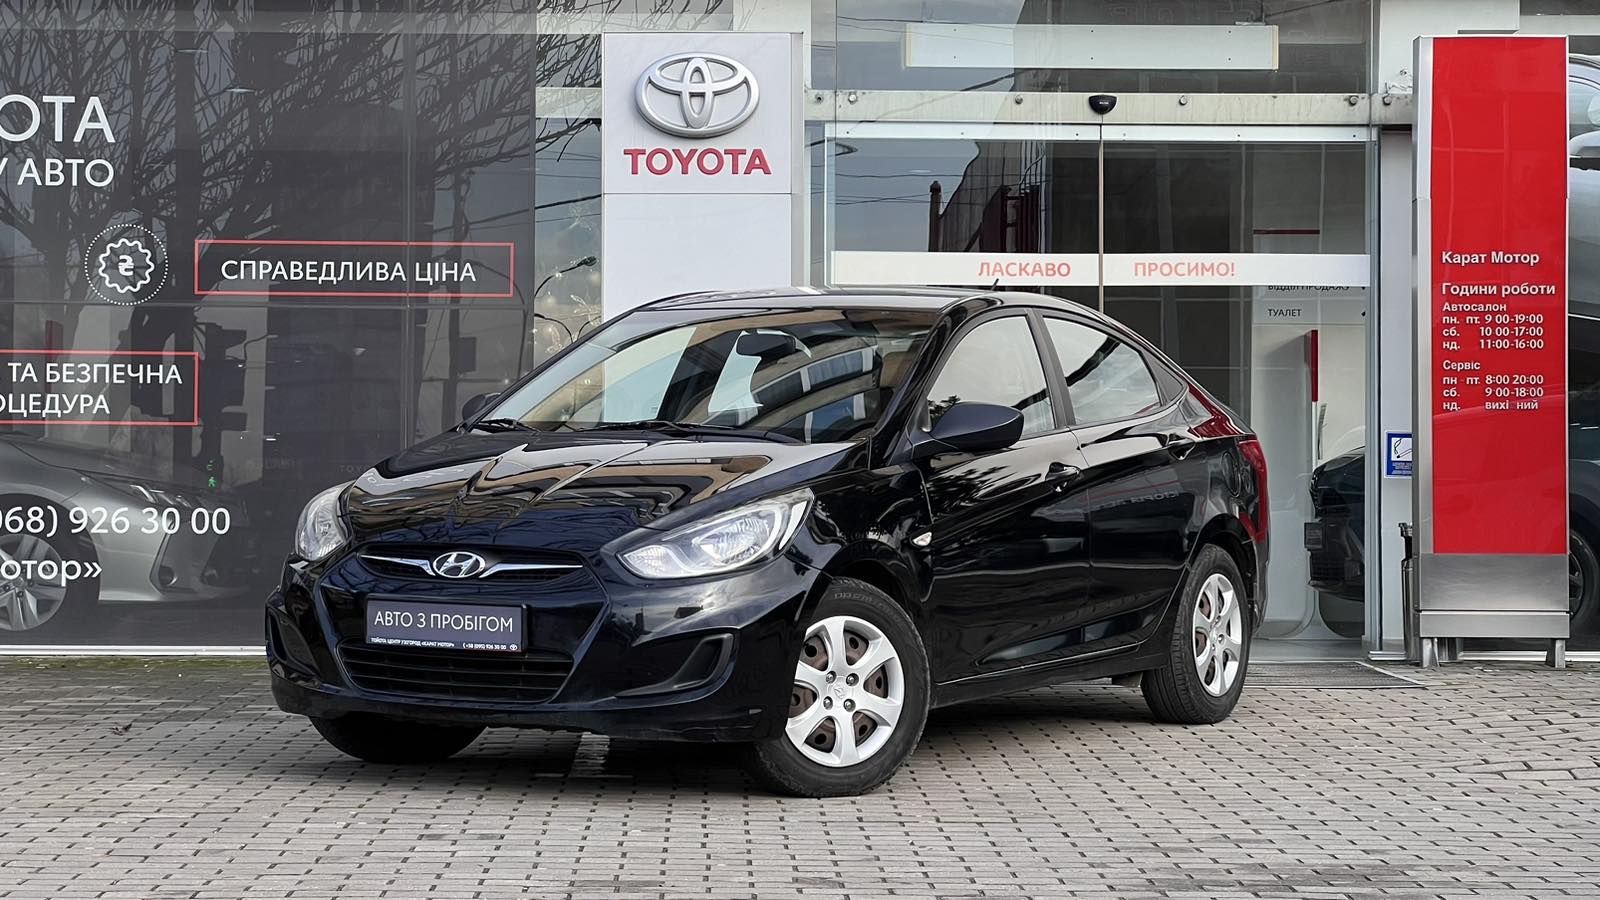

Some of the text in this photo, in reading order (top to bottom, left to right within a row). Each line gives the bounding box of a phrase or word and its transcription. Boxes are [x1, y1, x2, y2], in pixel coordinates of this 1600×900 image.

[624, 148, 772, 175] TOYOTA
[17, 158, 114, 187] АВТО
[1442, 251, 1540, 266] Карат Мотор
[221, 259, 476, 285] СПРАВЕДЛИВА ЦІНА
[978, 262, 1071, 277] ЛАСКАВО
[1134, 262, 1235, 277] ПРОСИМО!
[1442, 283, 1555, 297] Години роботи
[1268, 309, 1302, 317] ТУАЛЕТ
[1442, 302, 1507, 312] Автосалон
[1442, 316, 1460, 324] пн.
[1442, 327, 1460, 336] сб.
[1442, 341, 1460, 350] нд.
[8, 362, 182, 384] ТА БЕЗПЕЧНА
[1443, 360, 1480, 372] Сервіс
[1443, 402, 1460, 411] нд.
[0, 505, 230, 537] 68) 926 30 00
[374, 611, 513, 632] АВТО З ПРОБІГОМ
